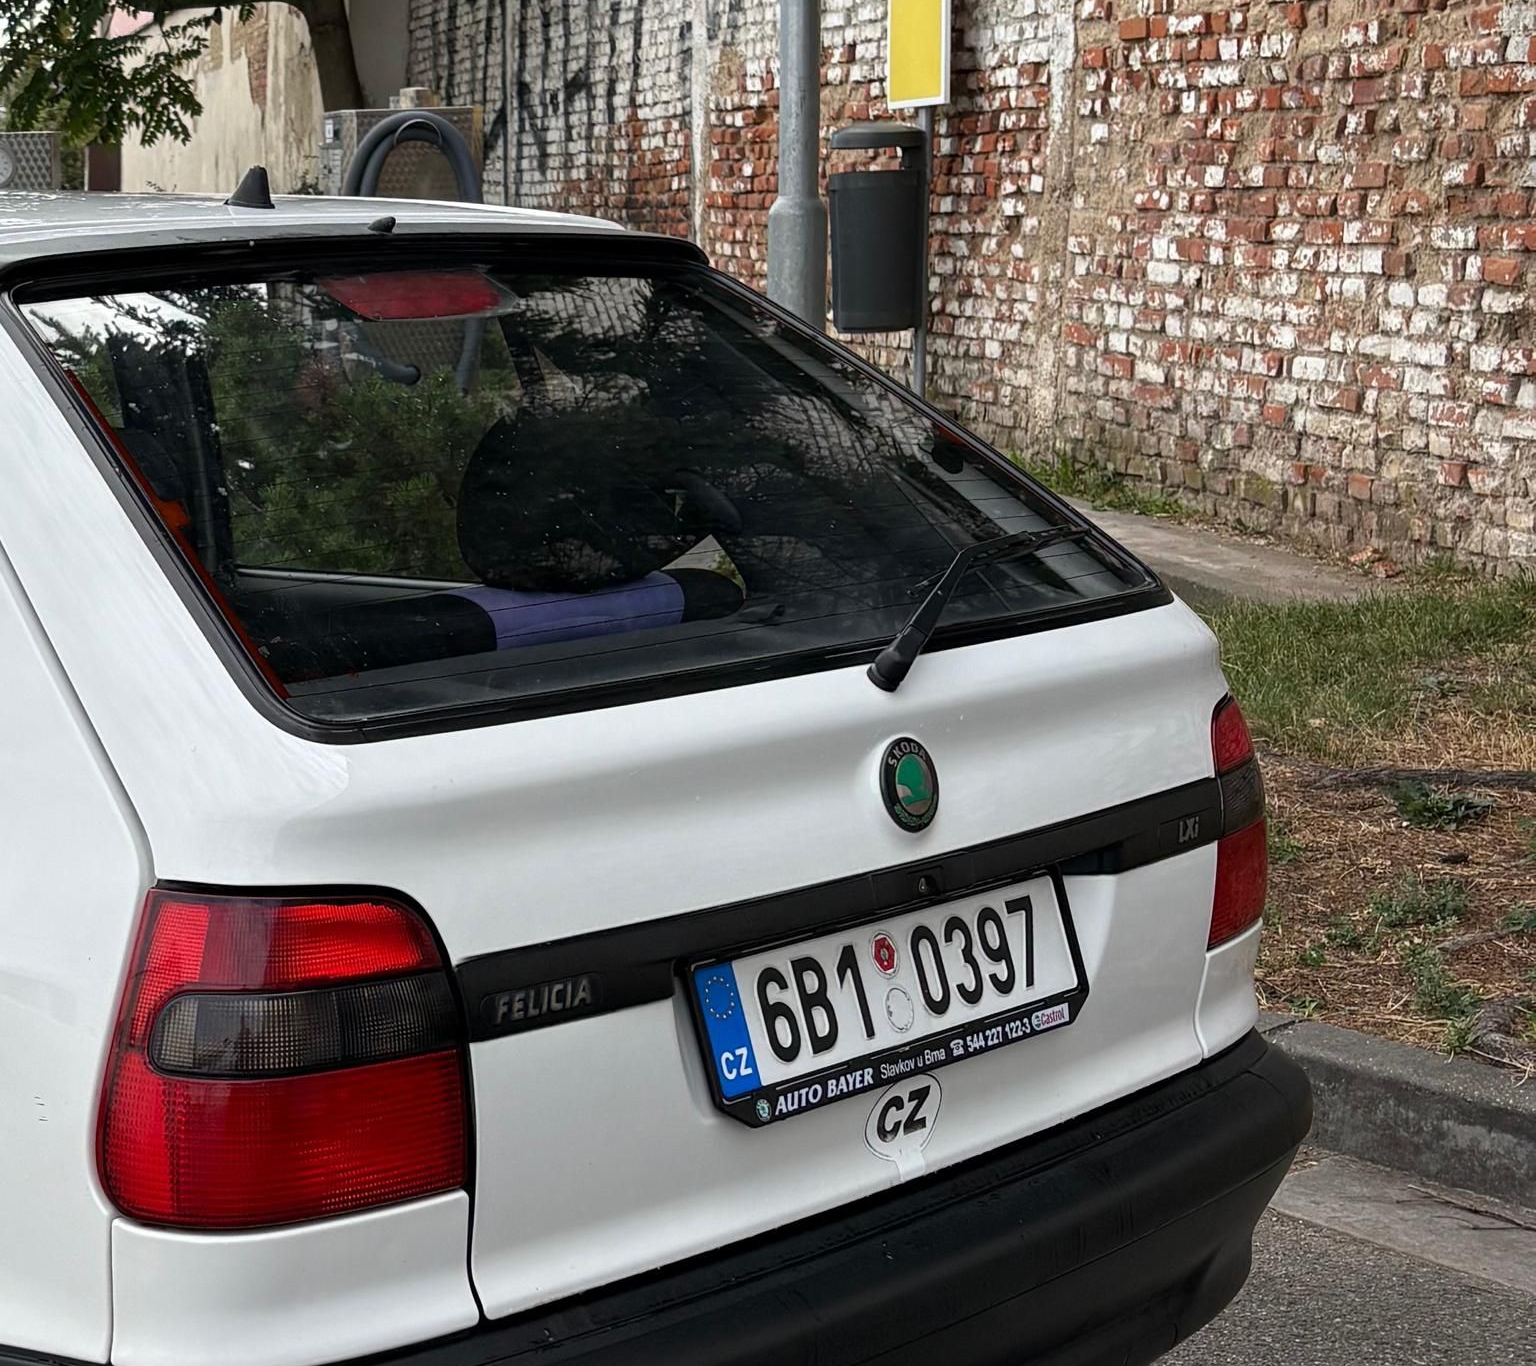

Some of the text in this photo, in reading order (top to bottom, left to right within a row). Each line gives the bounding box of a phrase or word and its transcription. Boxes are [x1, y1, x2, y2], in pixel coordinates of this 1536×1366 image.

[496, 977, 591, 1025] FELICIA
[756, 895, 1035, 1063] 6B1 0397
[1040, 1006, 1066, 1027] Castrol
[721, 1047, 752, 1080] CZ
[775, 1084, 822, 1116] AUTO
[827, 1067, 874, 1098] BAYER
[880, 1057, 915, 1080] Slavkov
[917, 1055, 924, 1067] u
[966, 1033, 986, 1053] 544
[987, 1026, 1003, 1046] 227
[877, 1085, 931, 1143] CZ
